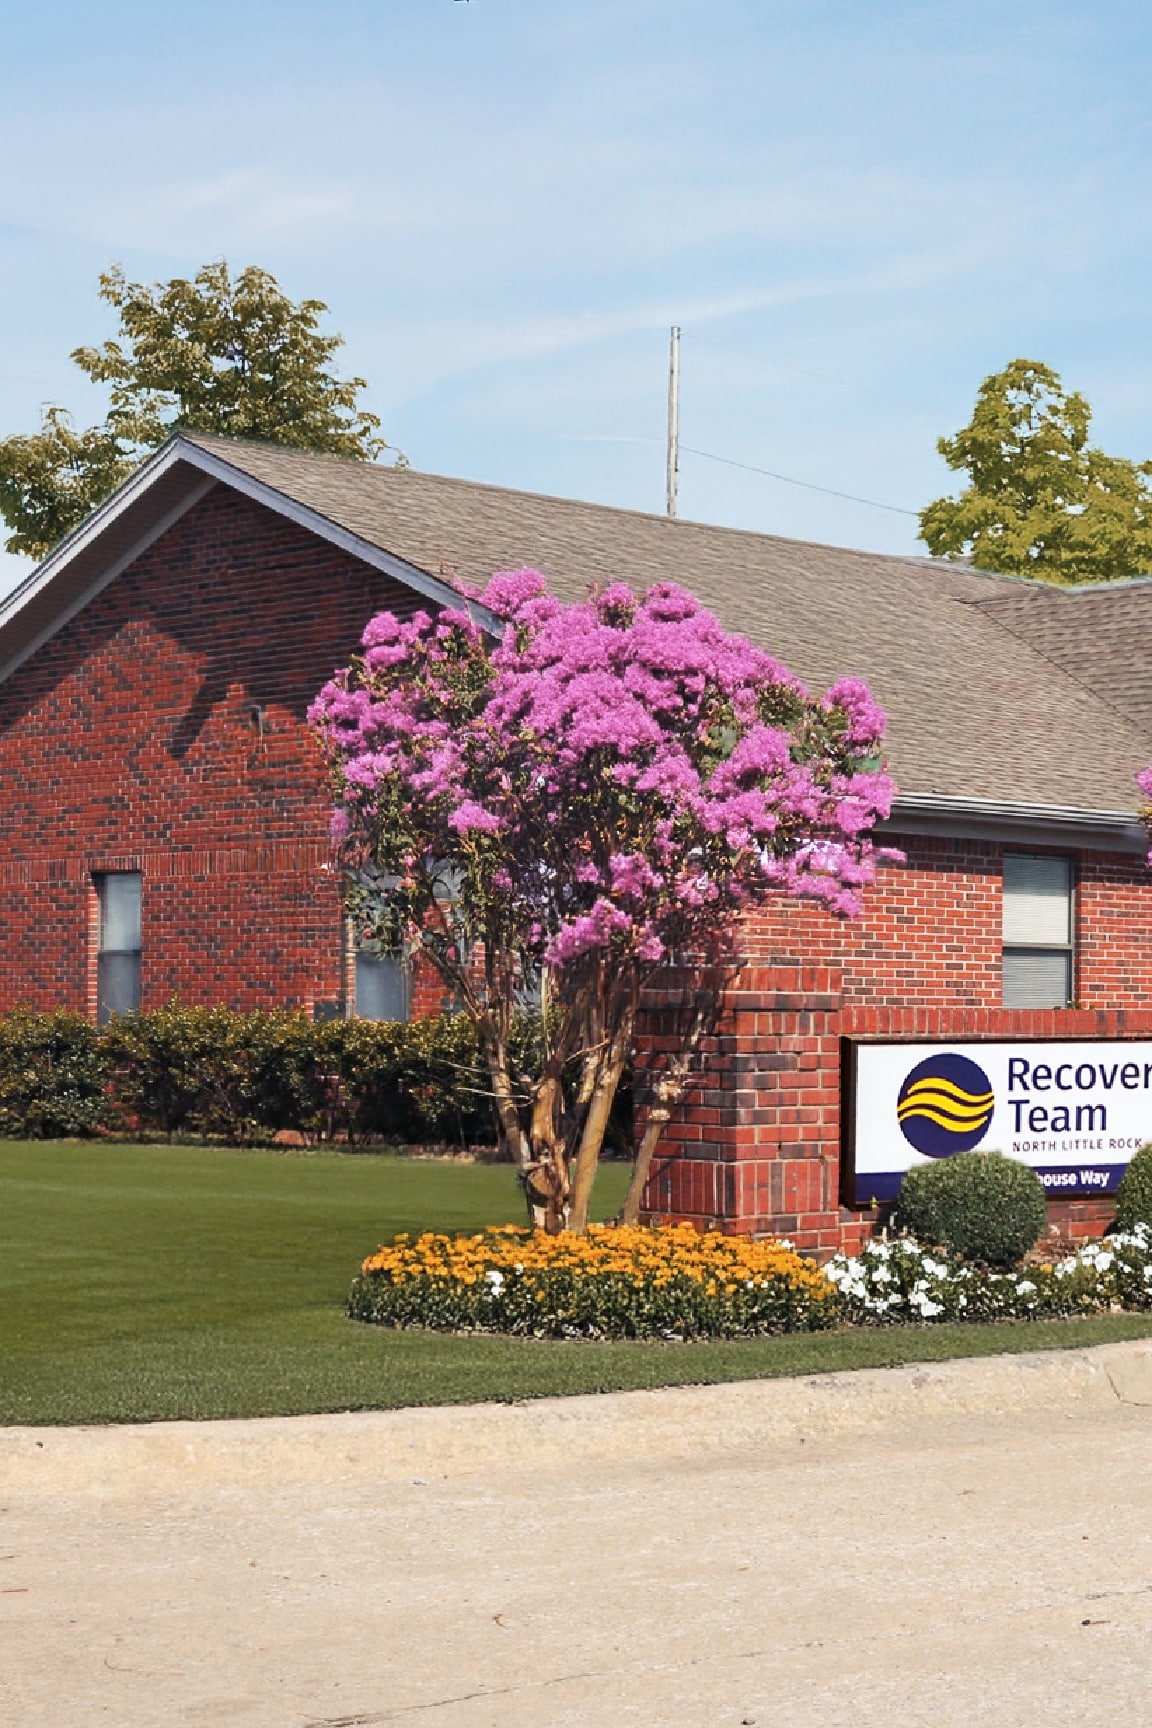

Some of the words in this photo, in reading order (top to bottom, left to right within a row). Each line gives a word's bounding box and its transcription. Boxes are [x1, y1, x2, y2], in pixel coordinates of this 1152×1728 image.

[1008, 1099, 1107, 1133] Team
[1012, 1141, 1056, 1152] NORTH
[1062, 1139, 1103, 1151] LITTLE
[1109, 1138, 1142, 1149] ROCK
[1080, 1170, 1110, 1187] Way
